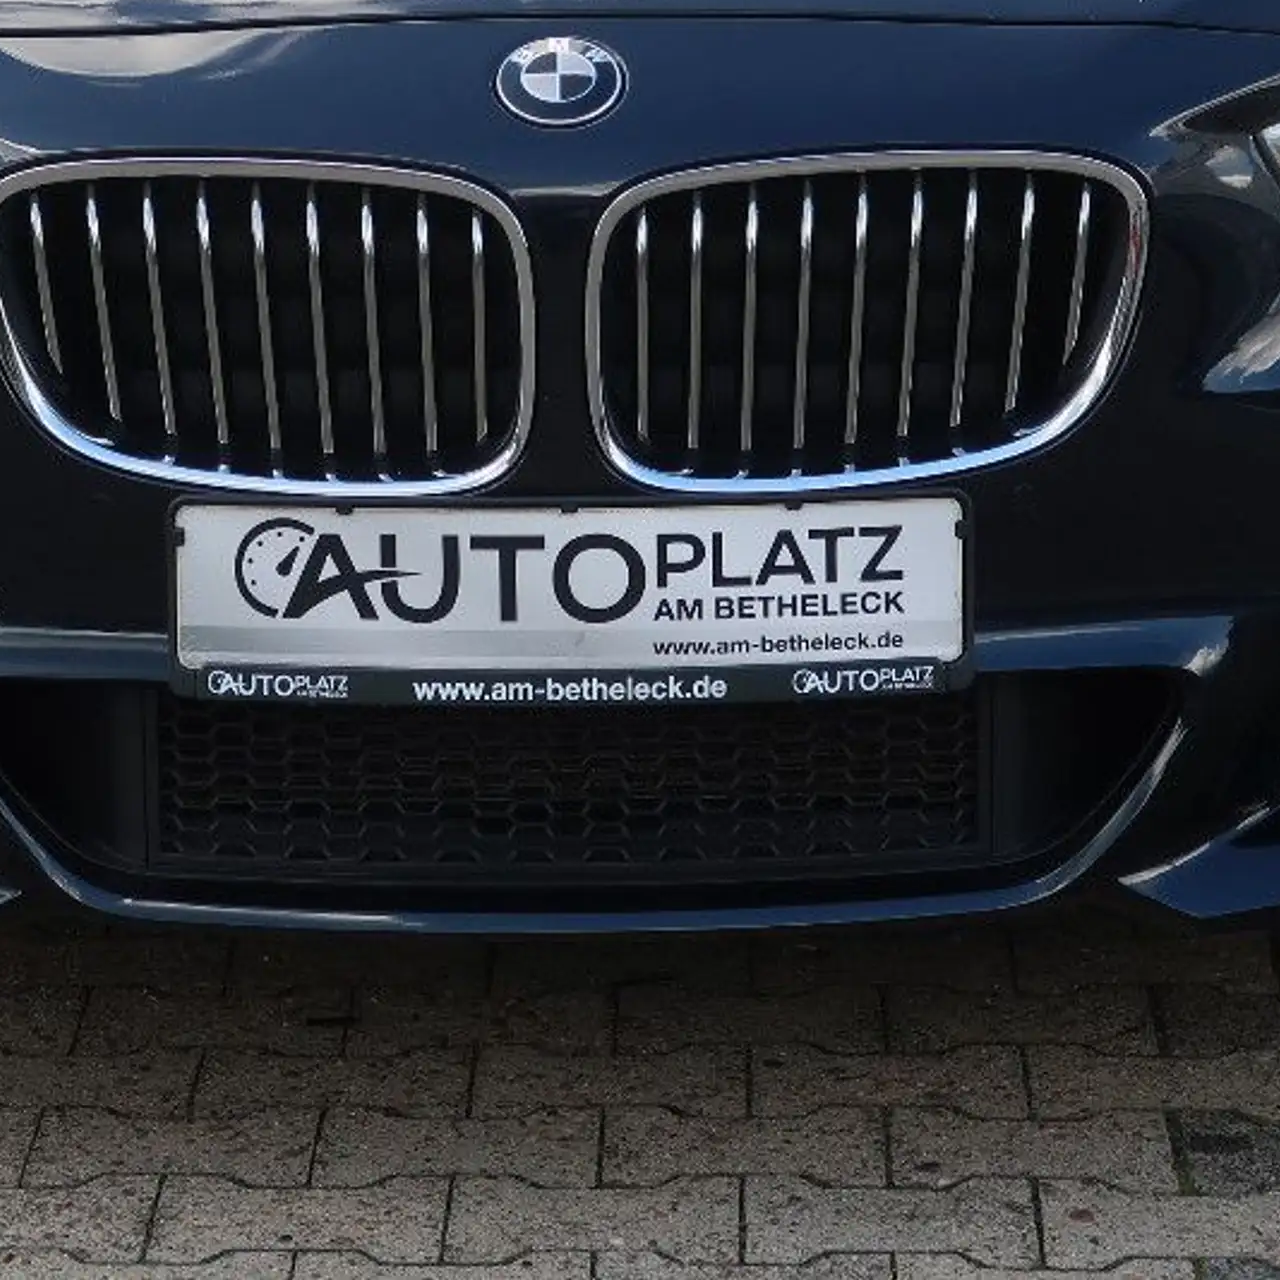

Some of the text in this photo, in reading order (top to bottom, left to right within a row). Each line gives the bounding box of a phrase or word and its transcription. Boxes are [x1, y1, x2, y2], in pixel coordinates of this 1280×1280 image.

[653, 591, 905, 621] AM BETHELECK
[652, 631, 904, 656] www.am-betheleck.de
[412, 675, 728, 701] www.am-betheleck.de
